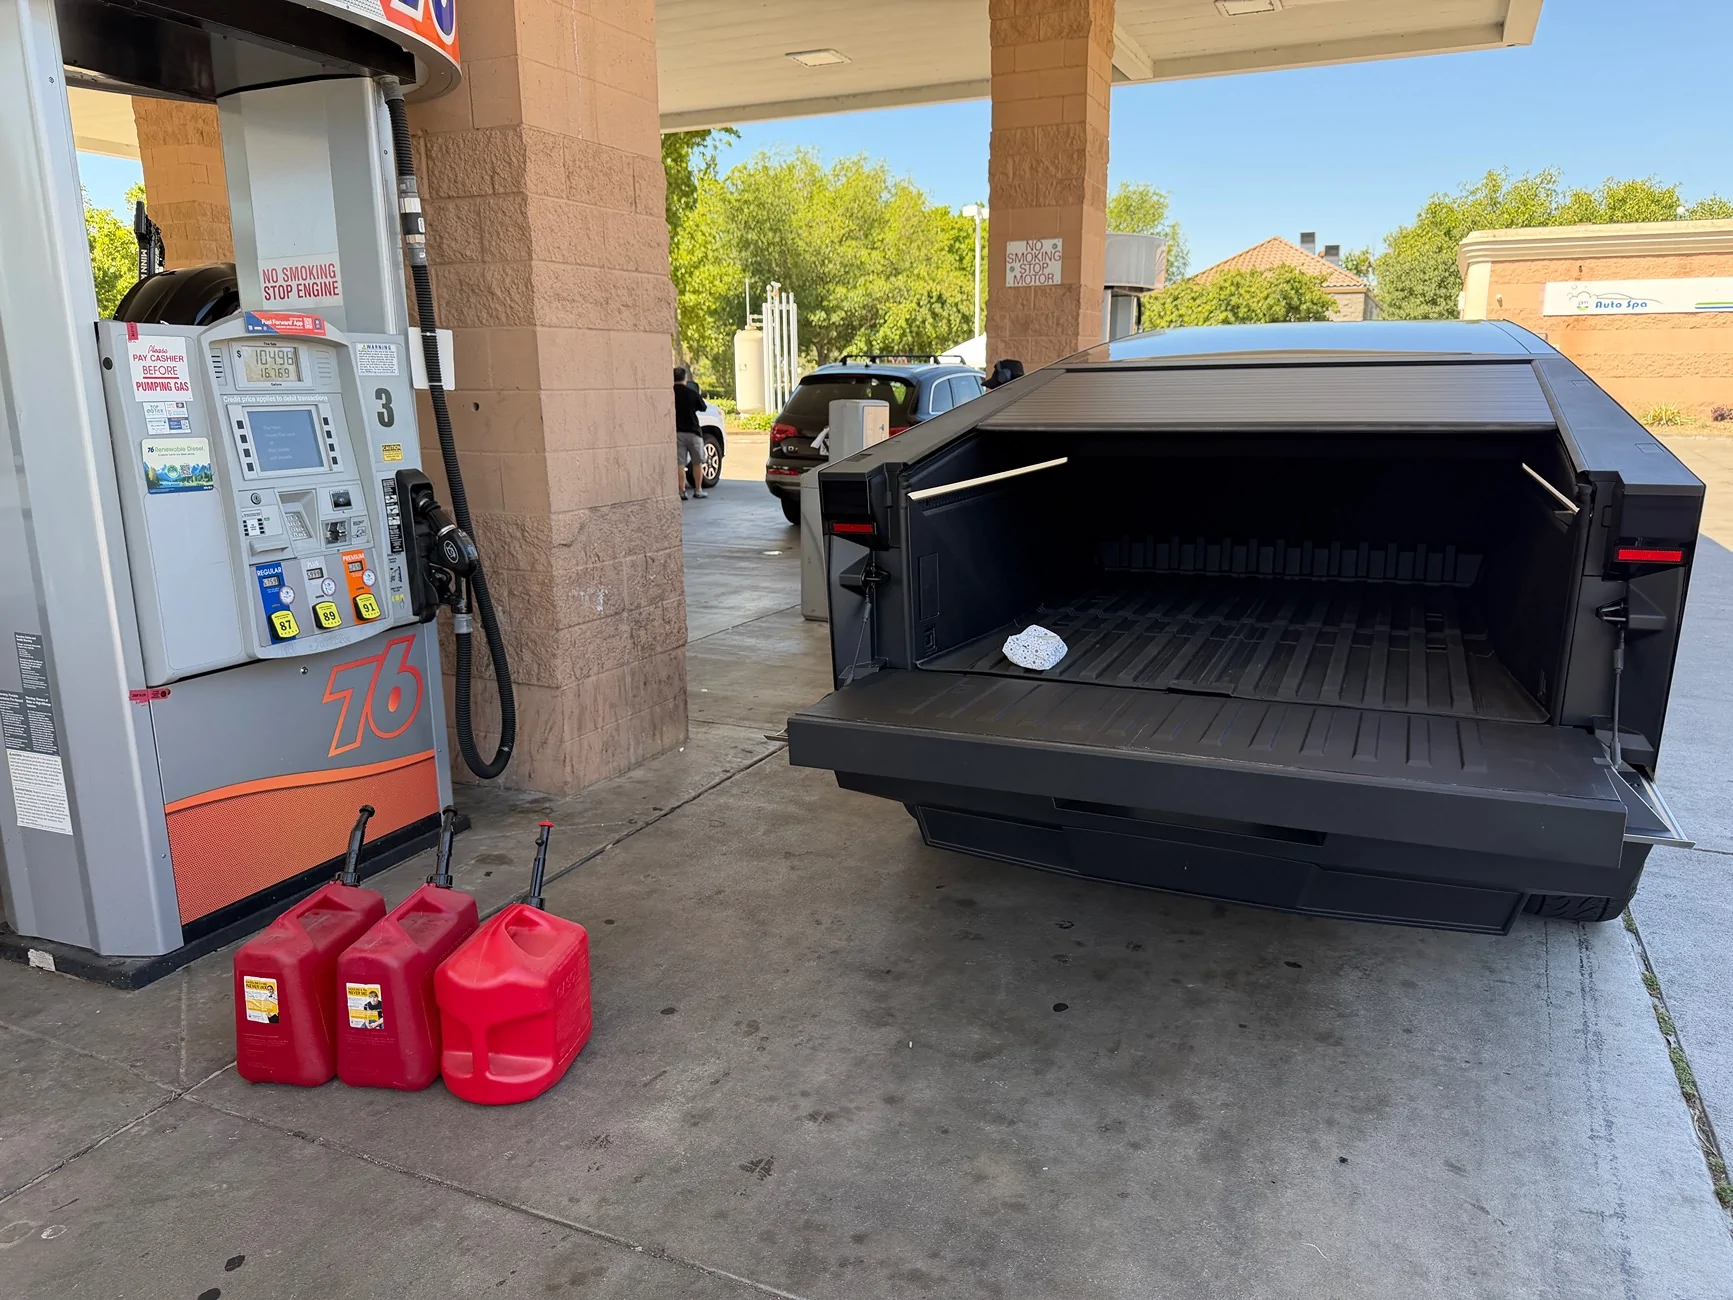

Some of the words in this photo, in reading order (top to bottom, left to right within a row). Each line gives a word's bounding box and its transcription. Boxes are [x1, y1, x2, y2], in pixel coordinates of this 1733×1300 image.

[1025, 240, 1043, 251] NO
[1007, 250, 1062, 264] SMOKING
[262, 268, 278, 284] NO
[282, 263, 336, 282] SMOKING
[1019, 263, 1049, 275] STOP
[1013, 273, 1055, 285] MOTOR
[264, 284, 293, 301] STOP
[296, 281, 339, 298] ENGINE
[1595, 301, 1622, 309] Auto
[1626, 300, 1647, 310] Spa
[148, 345, 168, 354] Please
[236, 350, 242, 359] $
[150, 354, 184, 362] CASHIER
[255, 349, 294, 366] 104.96
[142, 365, 178, 375] BEFORE
[136, 382, 172, 392] PUMPING
[173, 382, 189, 392] GAS
[241, 396, 256, 404] price
[375, 388, 395, 428] 3
[342, 553, 364, 562] PREMIUM
[307, 560, 319, 568] PLUS
[257, 566, 282, 576] REGULAR
[362, 602, 376, 613] 91
[323, 611, 336, 622] 89
[279, 620, 292, 631] 87
[322, 634, 423, 758] 76
